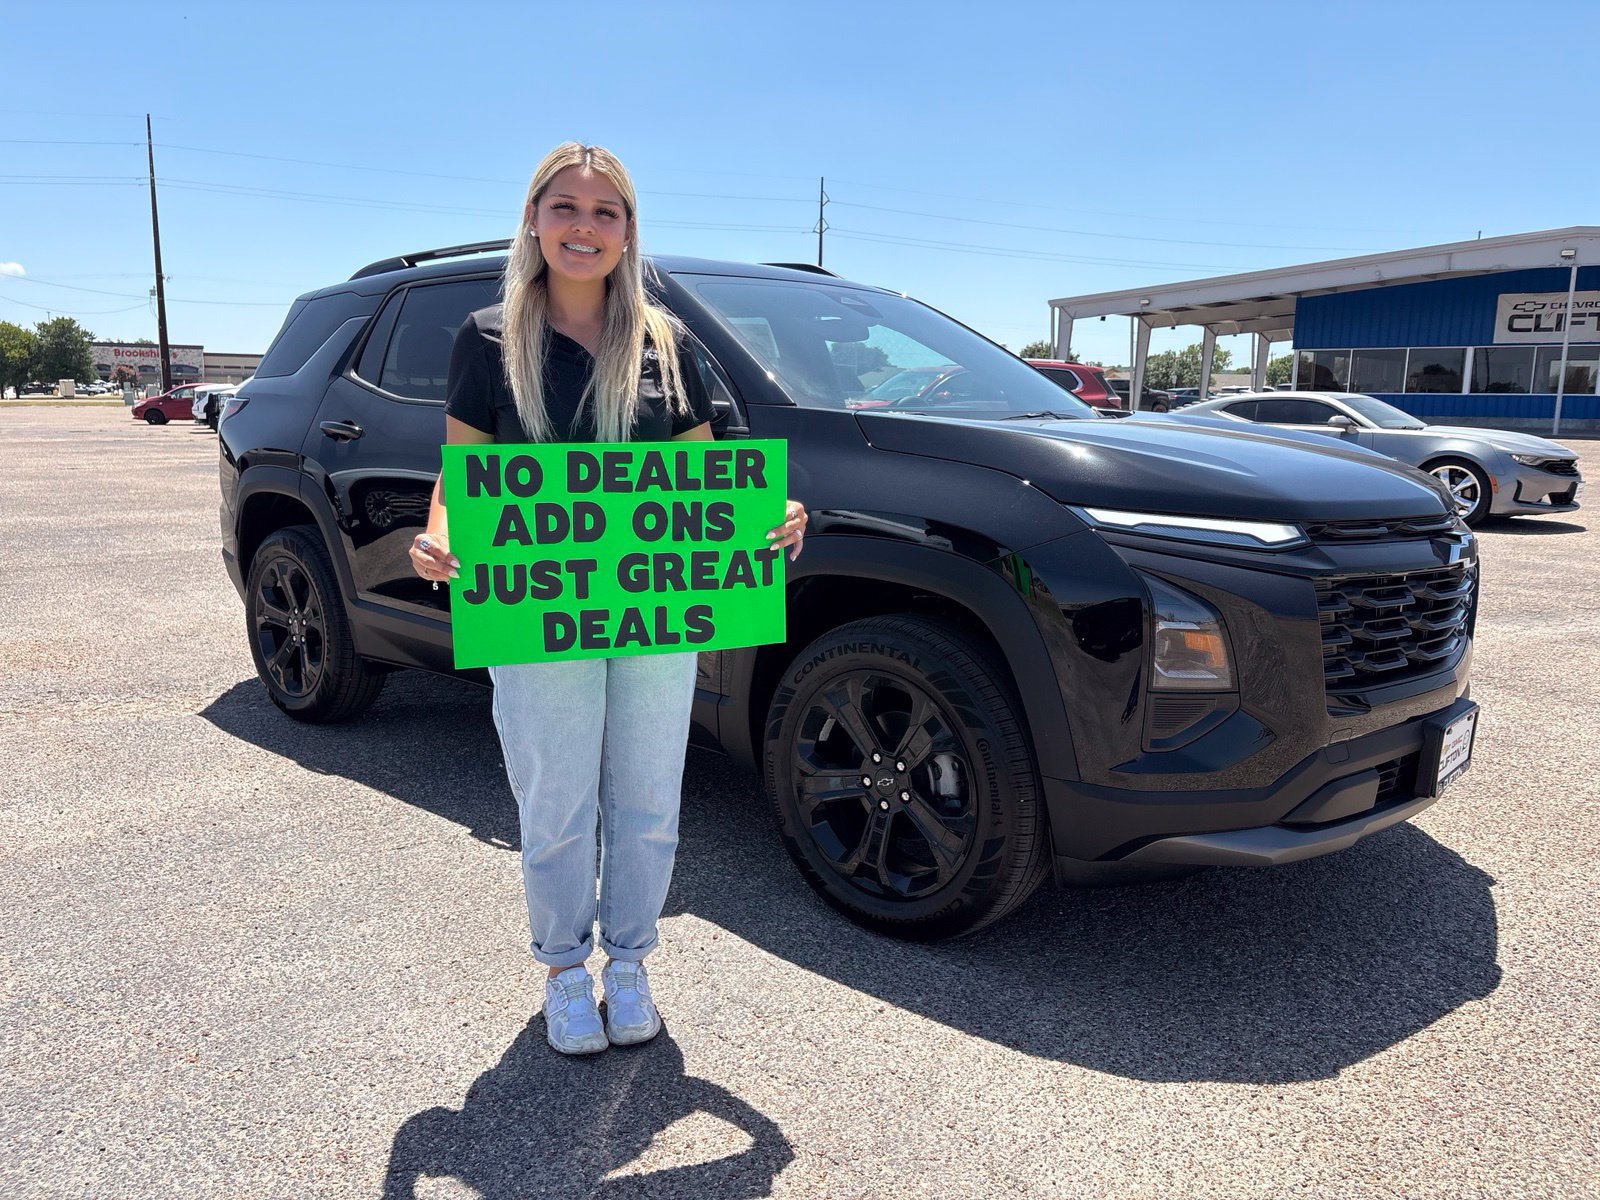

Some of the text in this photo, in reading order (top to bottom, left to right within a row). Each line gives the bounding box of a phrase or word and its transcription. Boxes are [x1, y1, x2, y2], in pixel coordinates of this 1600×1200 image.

[113, 348, 177, 359] Brookshis
[465, 449, 768, 498] NO DEALER
[492, 501, 736, 547] ADD ONS
[462, 548, 779, 605] JUST GREAT
[542, 604, 716, 653] DEALS
[793, 642, 924, 685] CONTINENTAL
[976, 737, 1004, 816] Continental
